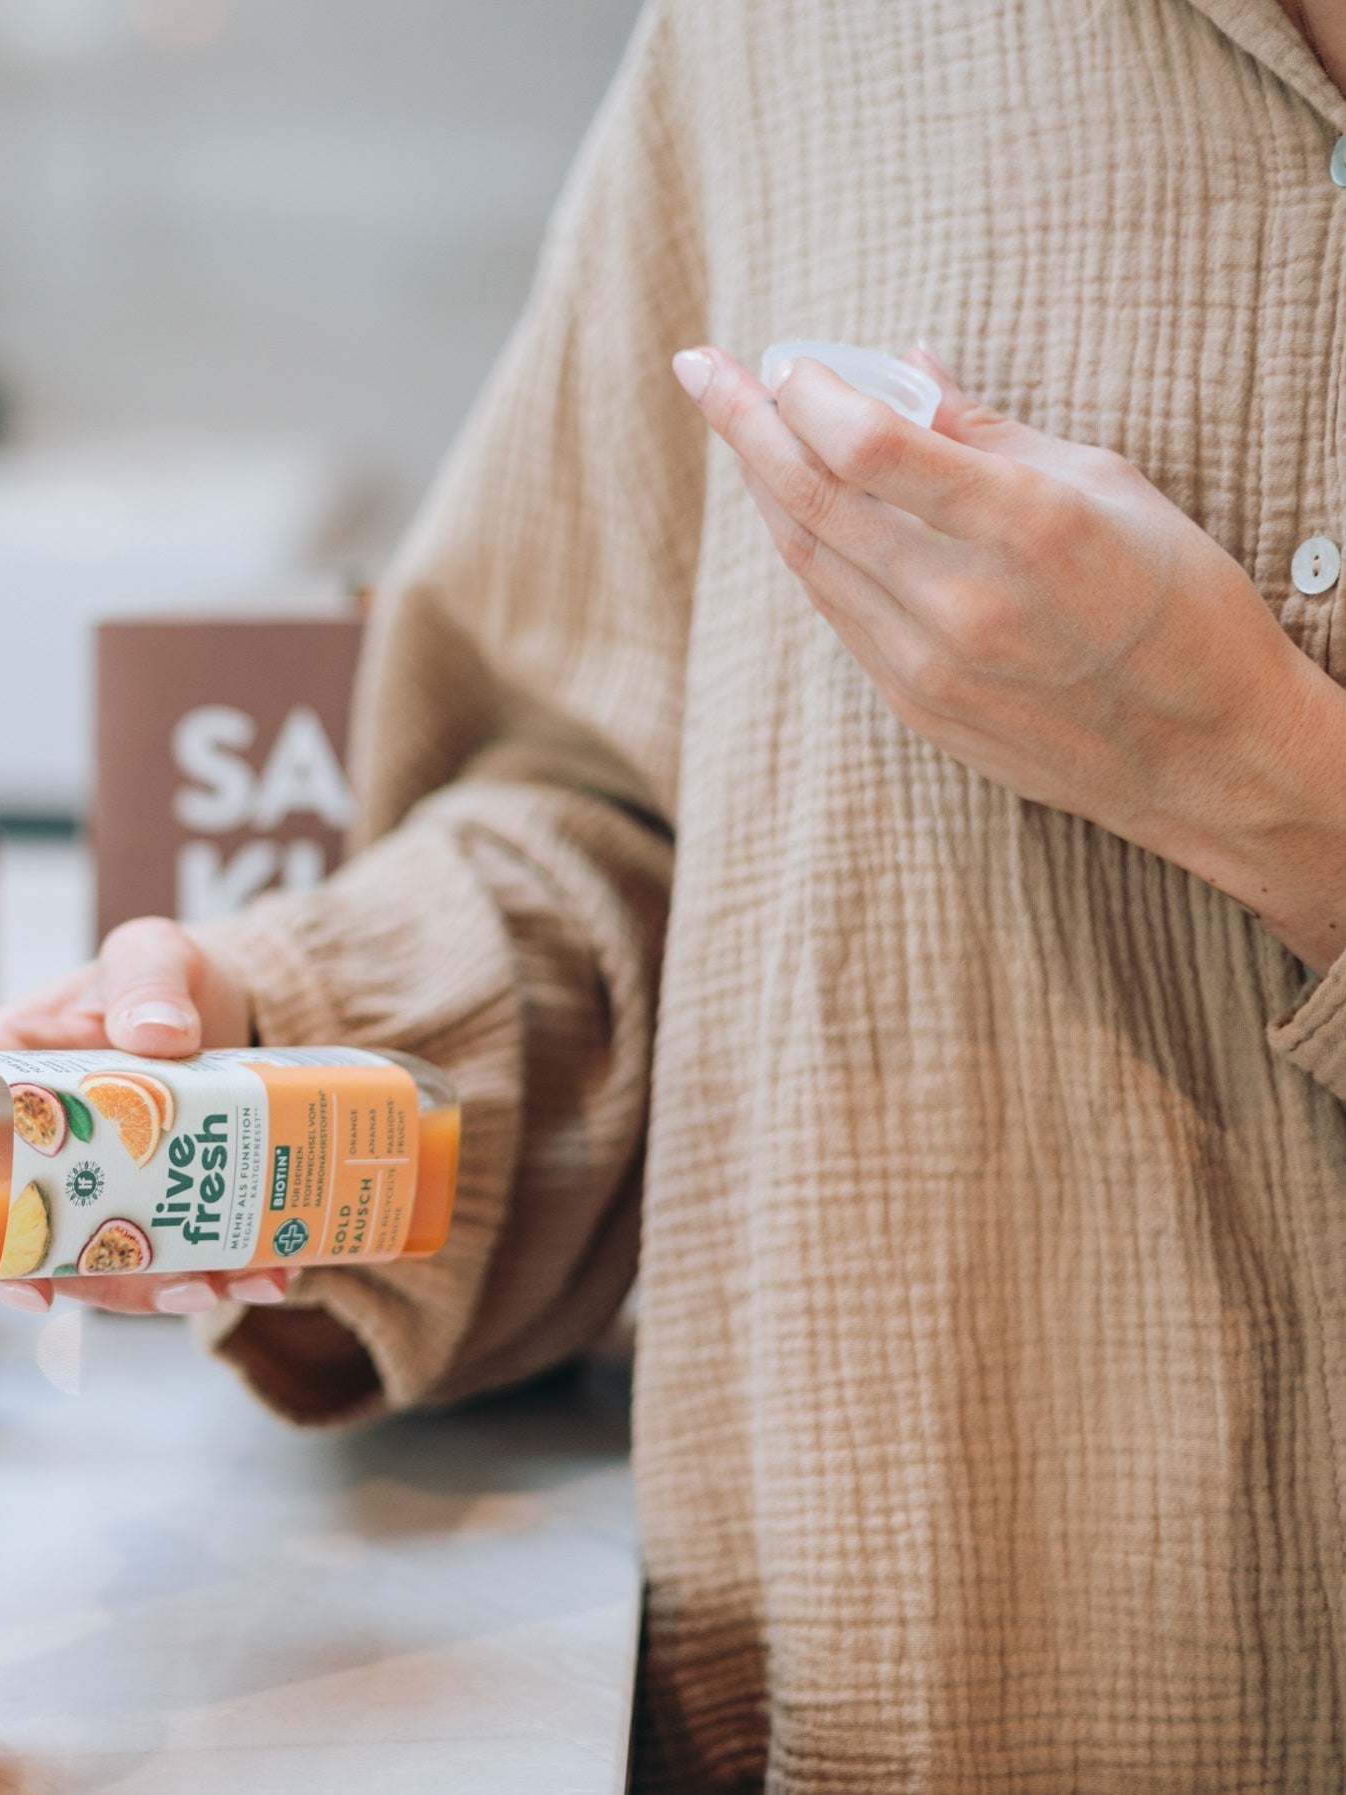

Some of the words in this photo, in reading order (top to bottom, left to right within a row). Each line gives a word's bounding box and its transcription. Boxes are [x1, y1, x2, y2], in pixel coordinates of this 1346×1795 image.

[171, 703, 357, 832] SA
[308, 1103, 316, 1127] VON
[349, 1109, 358, 1154] ORANGE
[369, 1109, 377, 1154] ANANAS
[398, 1110, 406, 1154] FRUCHT
[240, 1107, 251, 1179] FUNKTION
[294, 1146, 304, 1185] DEINEN
[151, 1134, 196, 1228] live
[183, 1114, 228, 1245] fresh
[303, 1129, 316, 1208] STOFFWECHSEL
[238, 1184, 249, 1208] ALS
[291, 1184, 301, 1208] FÜR
[348, 1178, 373, 1254] RAUSCH
[230, 1212, 244, 1250] MEHR
[242, 1212, 255, 1249] VEGAN
[331, 1205, 352, 1255] GOLD
